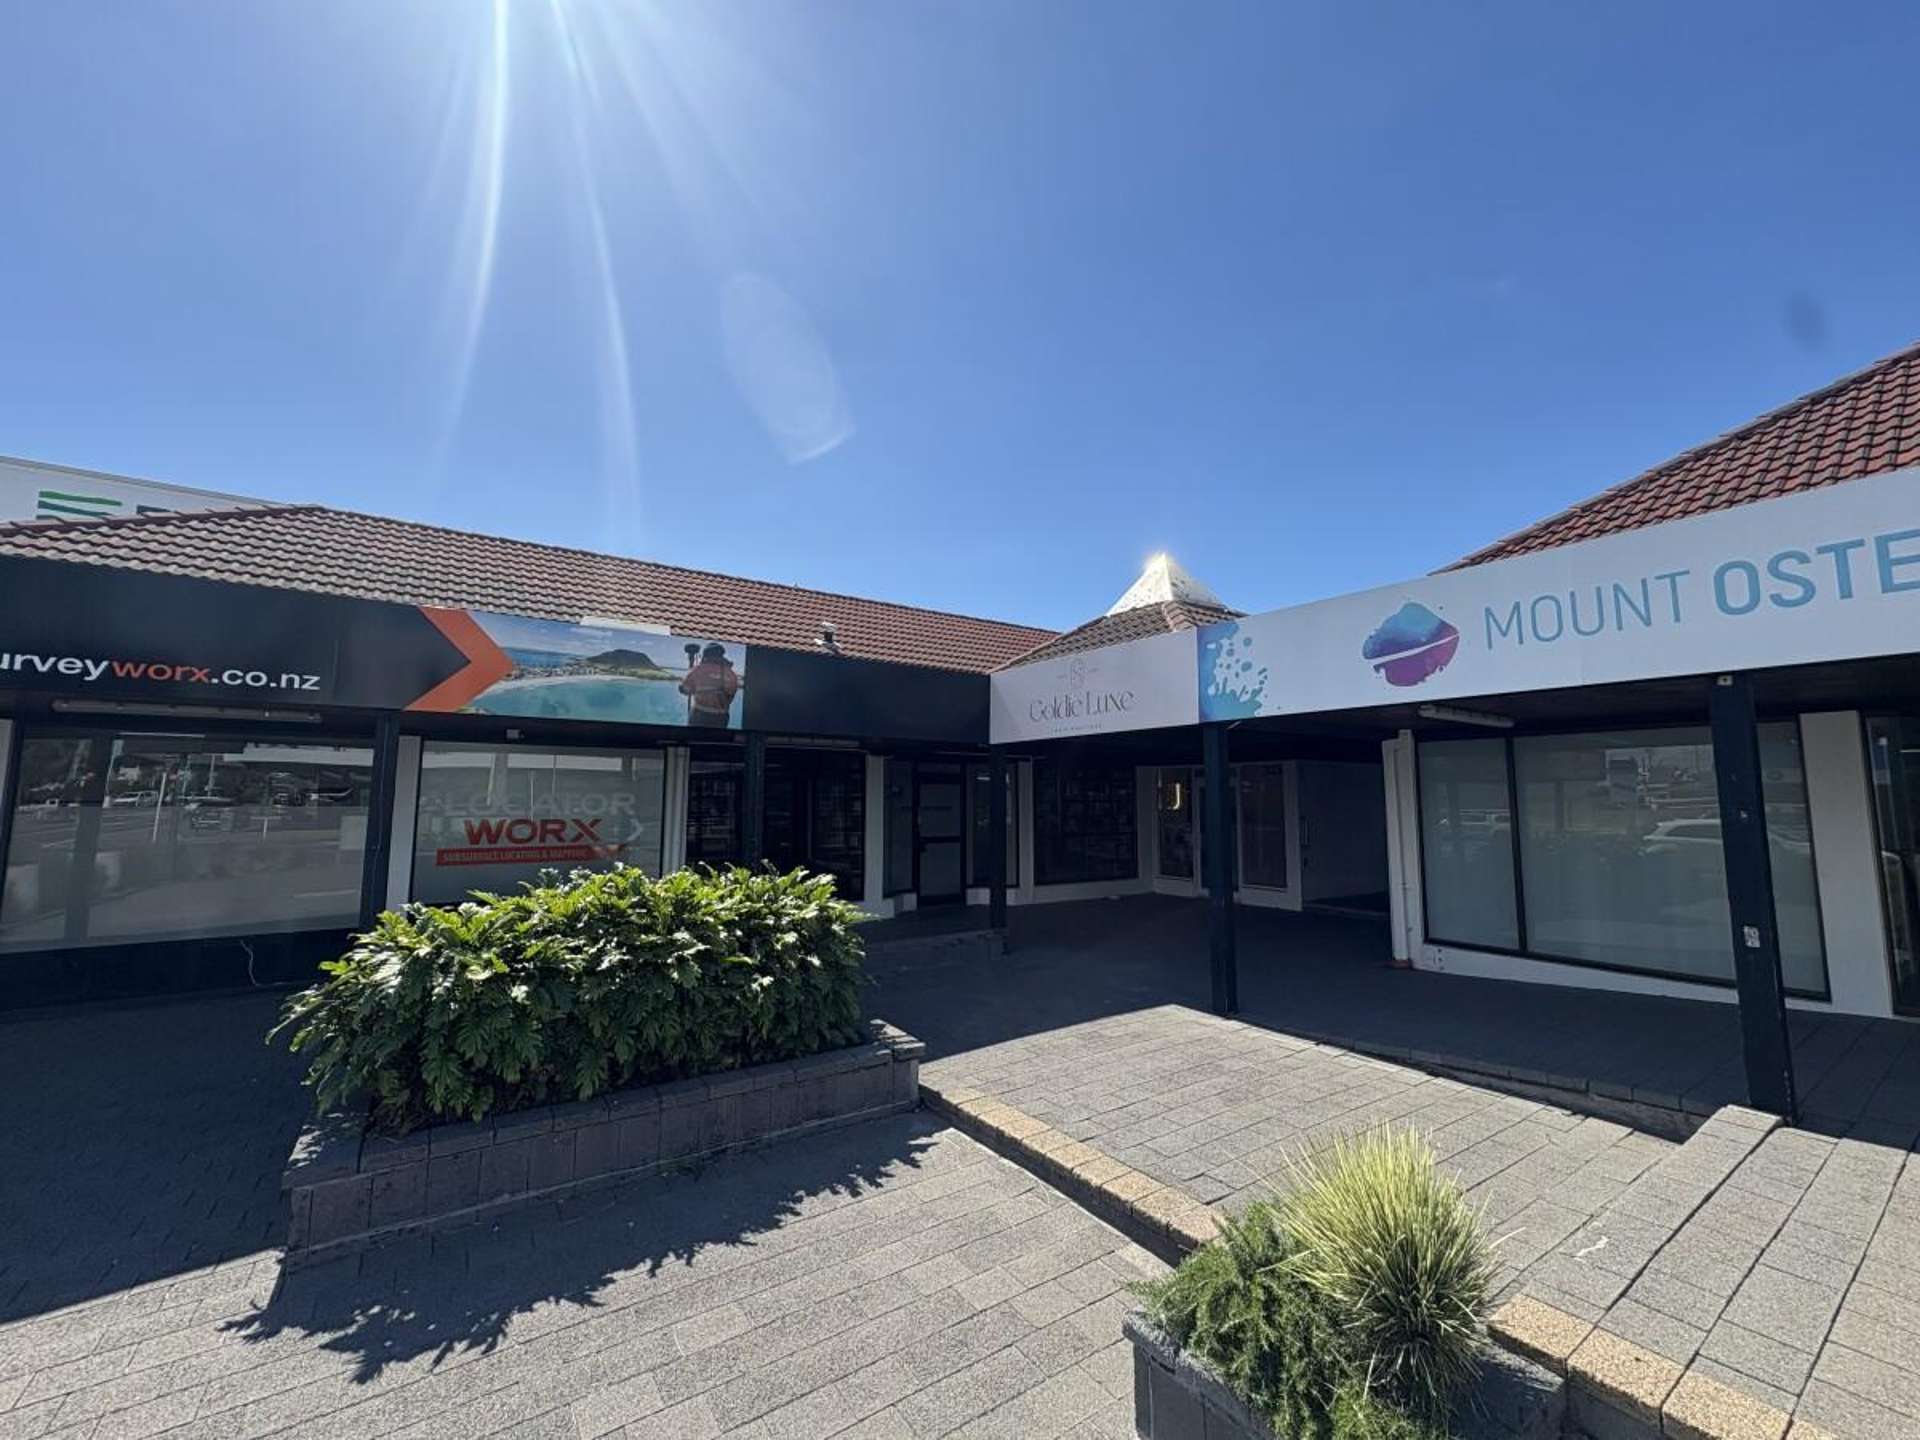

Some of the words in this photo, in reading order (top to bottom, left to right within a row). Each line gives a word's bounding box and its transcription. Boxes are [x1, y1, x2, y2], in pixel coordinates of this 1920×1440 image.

[1484, 570, 1692, 650] MOUNT
[1713, 528, 1920, 616] OSTE
[463, 818, 603, 846] WORX
